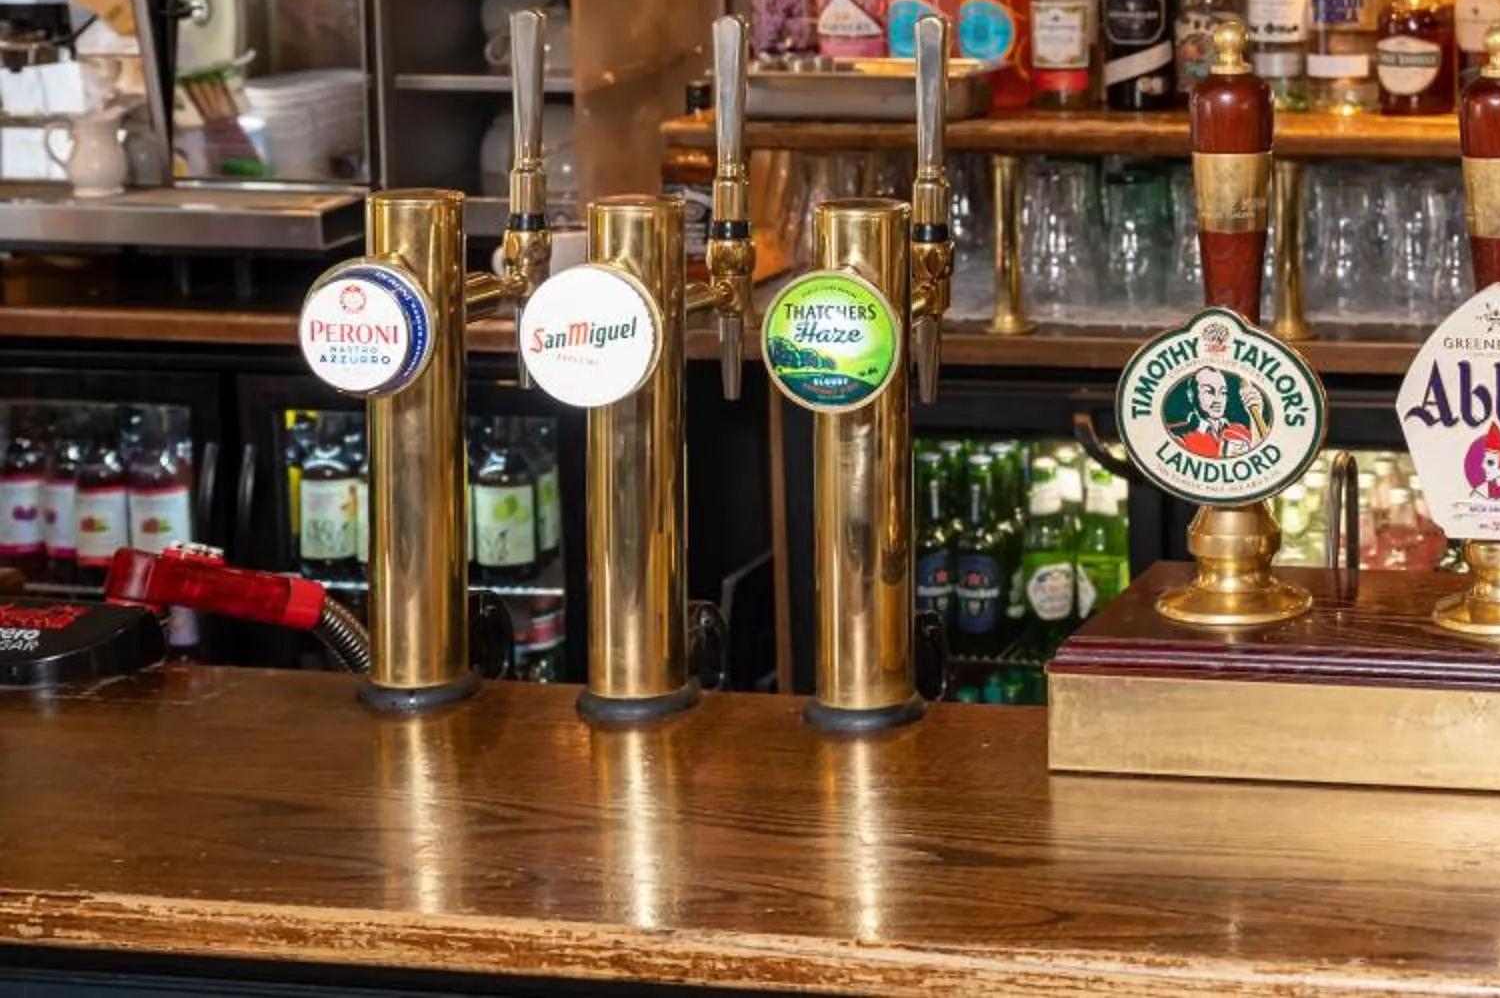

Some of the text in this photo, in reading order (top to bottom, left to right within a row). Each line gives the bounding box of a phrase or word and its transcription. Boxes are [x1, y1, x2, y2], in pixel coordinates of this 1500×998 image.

[784, 303, 877, 321] THATCHERS
[310, 319, 399, 344] PERONI
[794, 321, 864, 344] Haze
[1131, 337, 1310, 427] TIMOTHY TAYLOR'S
[1156, 441, 1281, 484] LANDLORD
